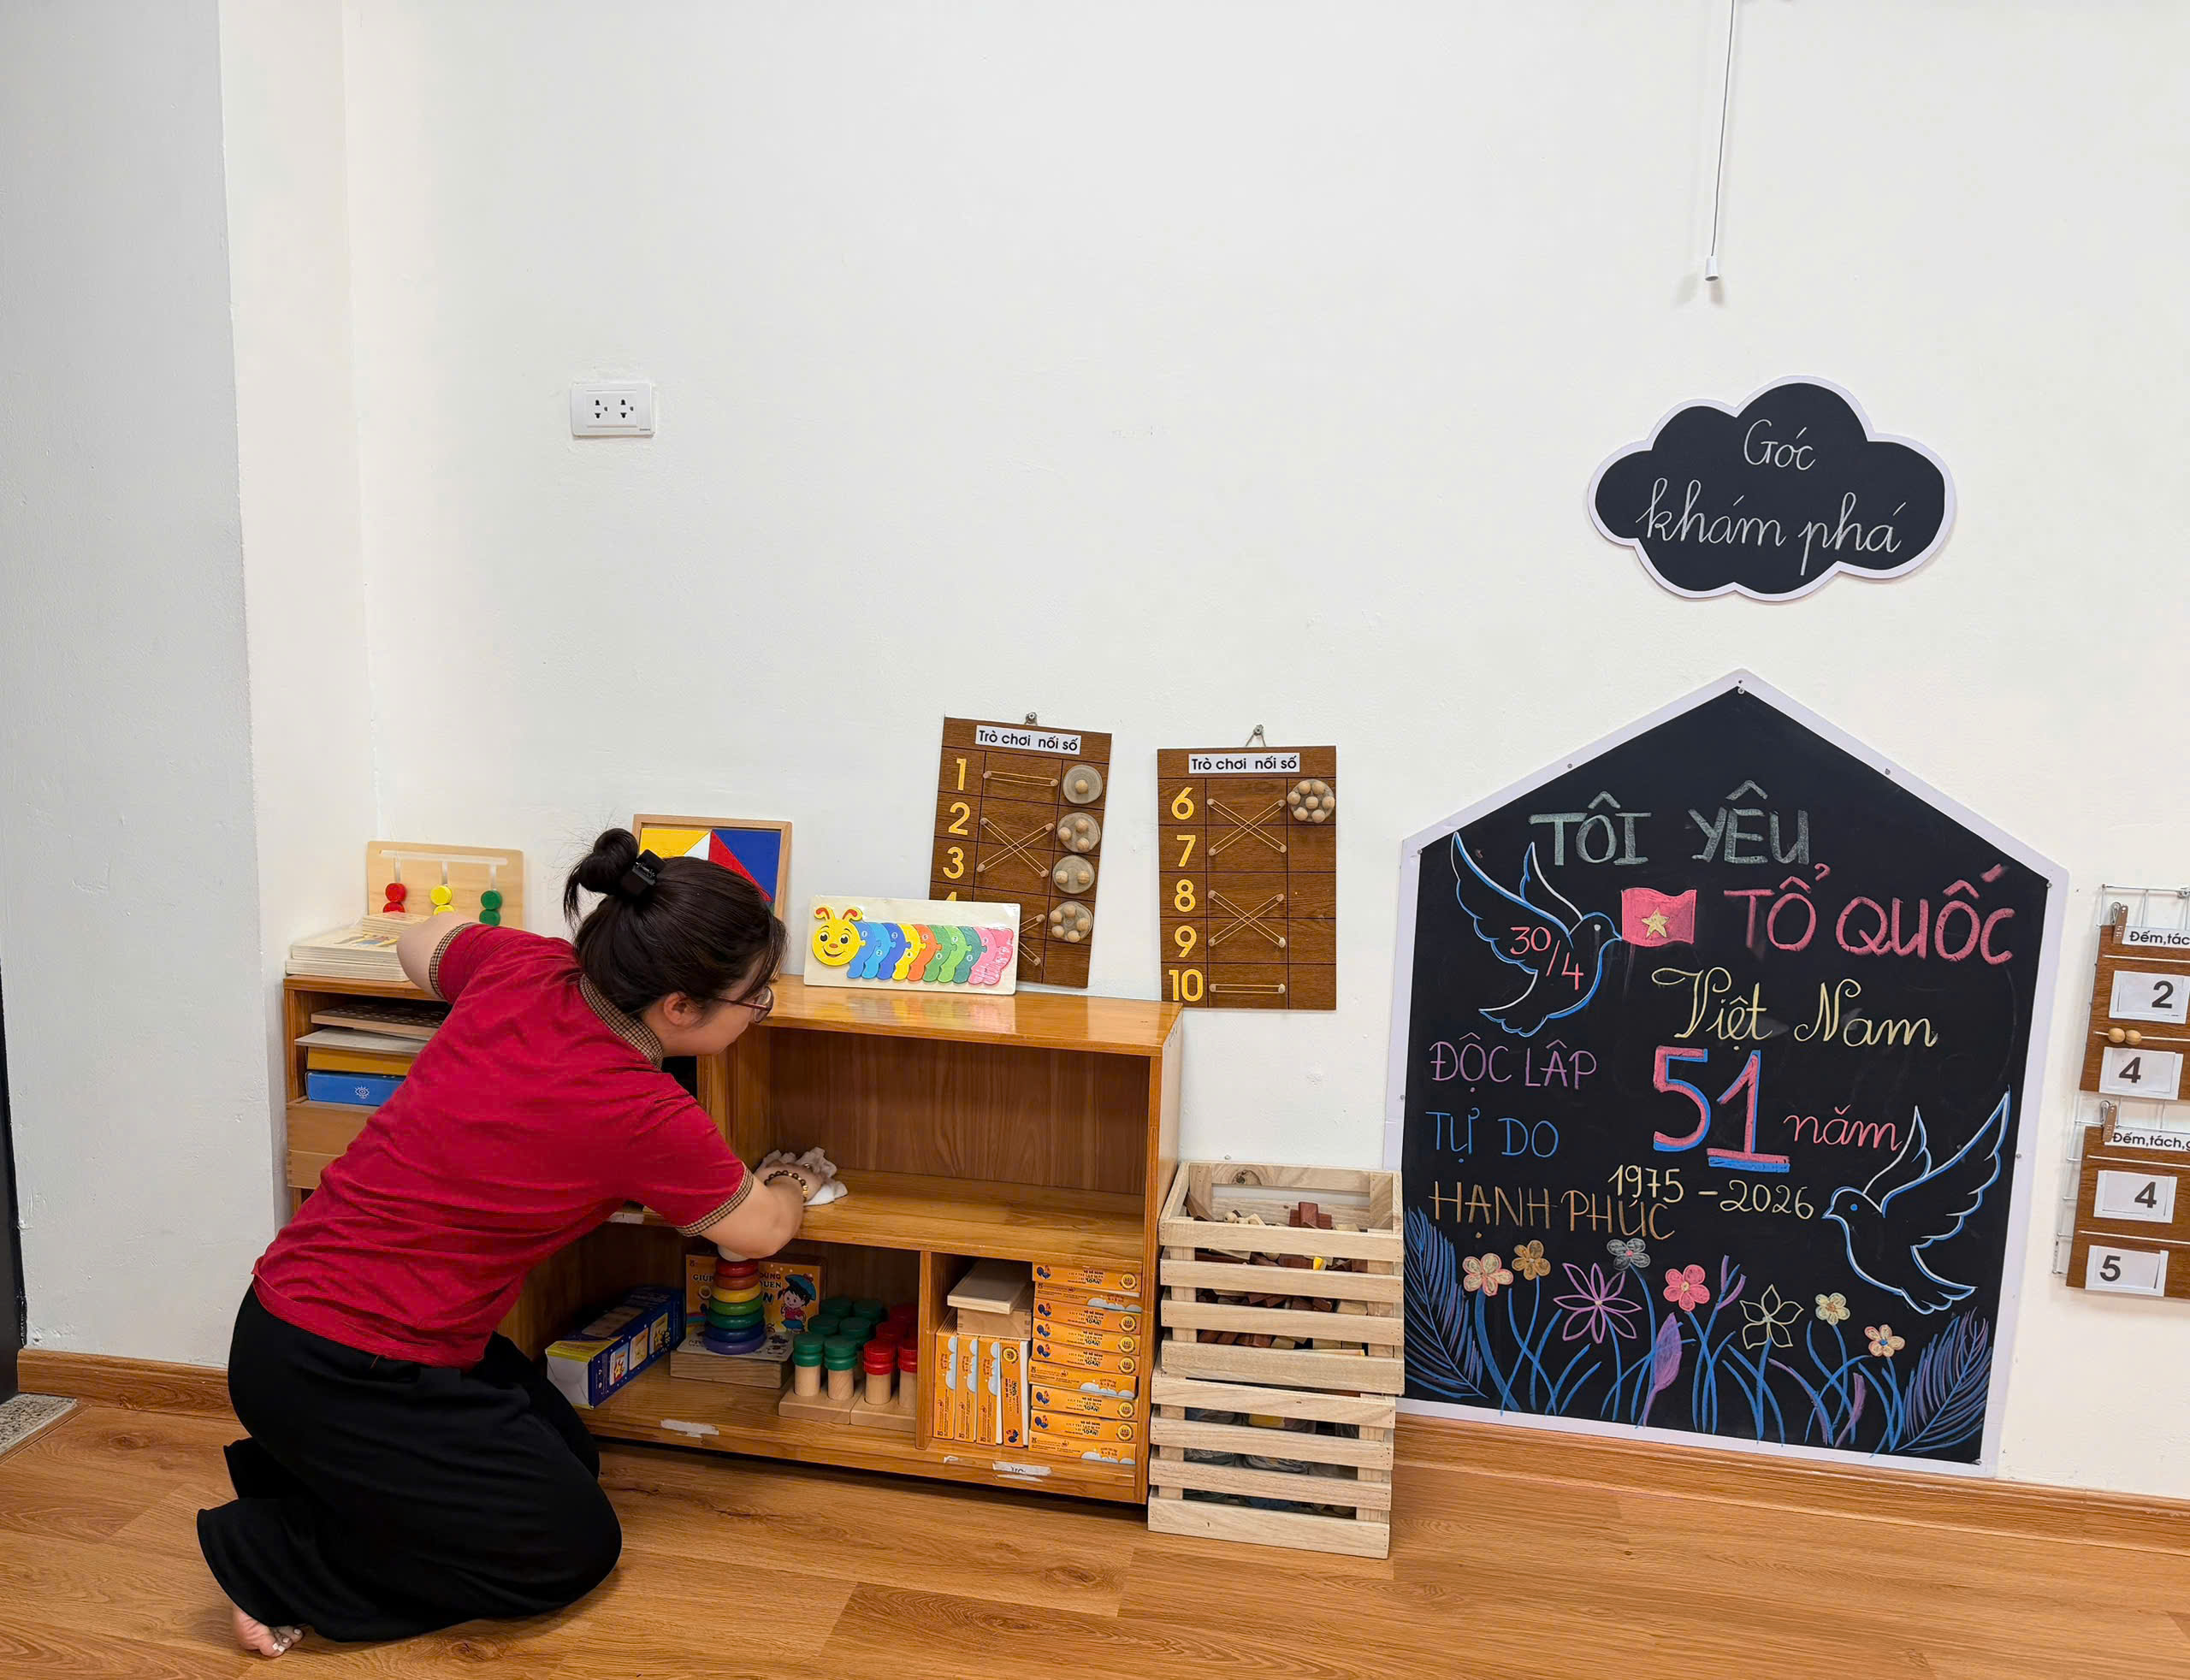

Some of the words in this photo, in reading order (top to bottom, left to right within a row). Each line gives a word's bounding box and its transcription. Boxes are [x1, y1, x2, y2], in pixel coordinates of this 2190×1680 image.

[1743, 418, 1816, 470] Góc
[1635, 477, 1787, 547] khám
[1797, 492, 1907, 576] phá
[979, 730, 998, 743] Trò
[1001, 733, 1031, 747] chơi
[1038, 736, 1059, 749] nối
[1062, 738, 1079, 751] số
[956, 758, 967, 791] 1
[1192, 757, 1212, 770] Trò
[1216, 758, 1246, 770] chơi
[1255, 755, 1276, 769] nối
[1281, 755, 1297, 769] số
[948, 802, 971, 836] 2
[1171, 786, 1194, 820] 6
[1529, 791, 1652, 866] TÔI
[1687, 780, 1810, 865] YÊU
[943, 846, 964, 879] 3
[1176, 834, 1196, 867] 7
[1174, 878, 1196, 913] 8
[1723, 862, 1831, 951] TỔ
[1835, 864, 2015, 965] QUỐC
[1174, 925, 1197, 958] 9
[1510, 926, 1584, 991] 30/4
[1169, 968, 1204, 1002] 10
[2151, 980, 2174, 1009] 2
[1651, 967, 1773, 1050] Việt
[1794, 979, 1938, 1047] Nam
[1429, 1032, 1512, 1092] ĐỘC
[2118, 1056, 2141, 1084] 4
[1653, 1044, 1790, 1173] 51
[1783, 1104, 1903, 1151] năm
[1425, 1107, 1480, 1163] TỰ
[1497, 1117, 1560, 1158] DO
[1607, 1163, 1684, 1204] 1975
[2134, 1180, 2157, 1210] 4
[1428, 1180, 1559, 1239] HẠNH
[1560, 1190, 1676, 1240] PHÚC
[2098, 1255, 2122, 1282] 5
